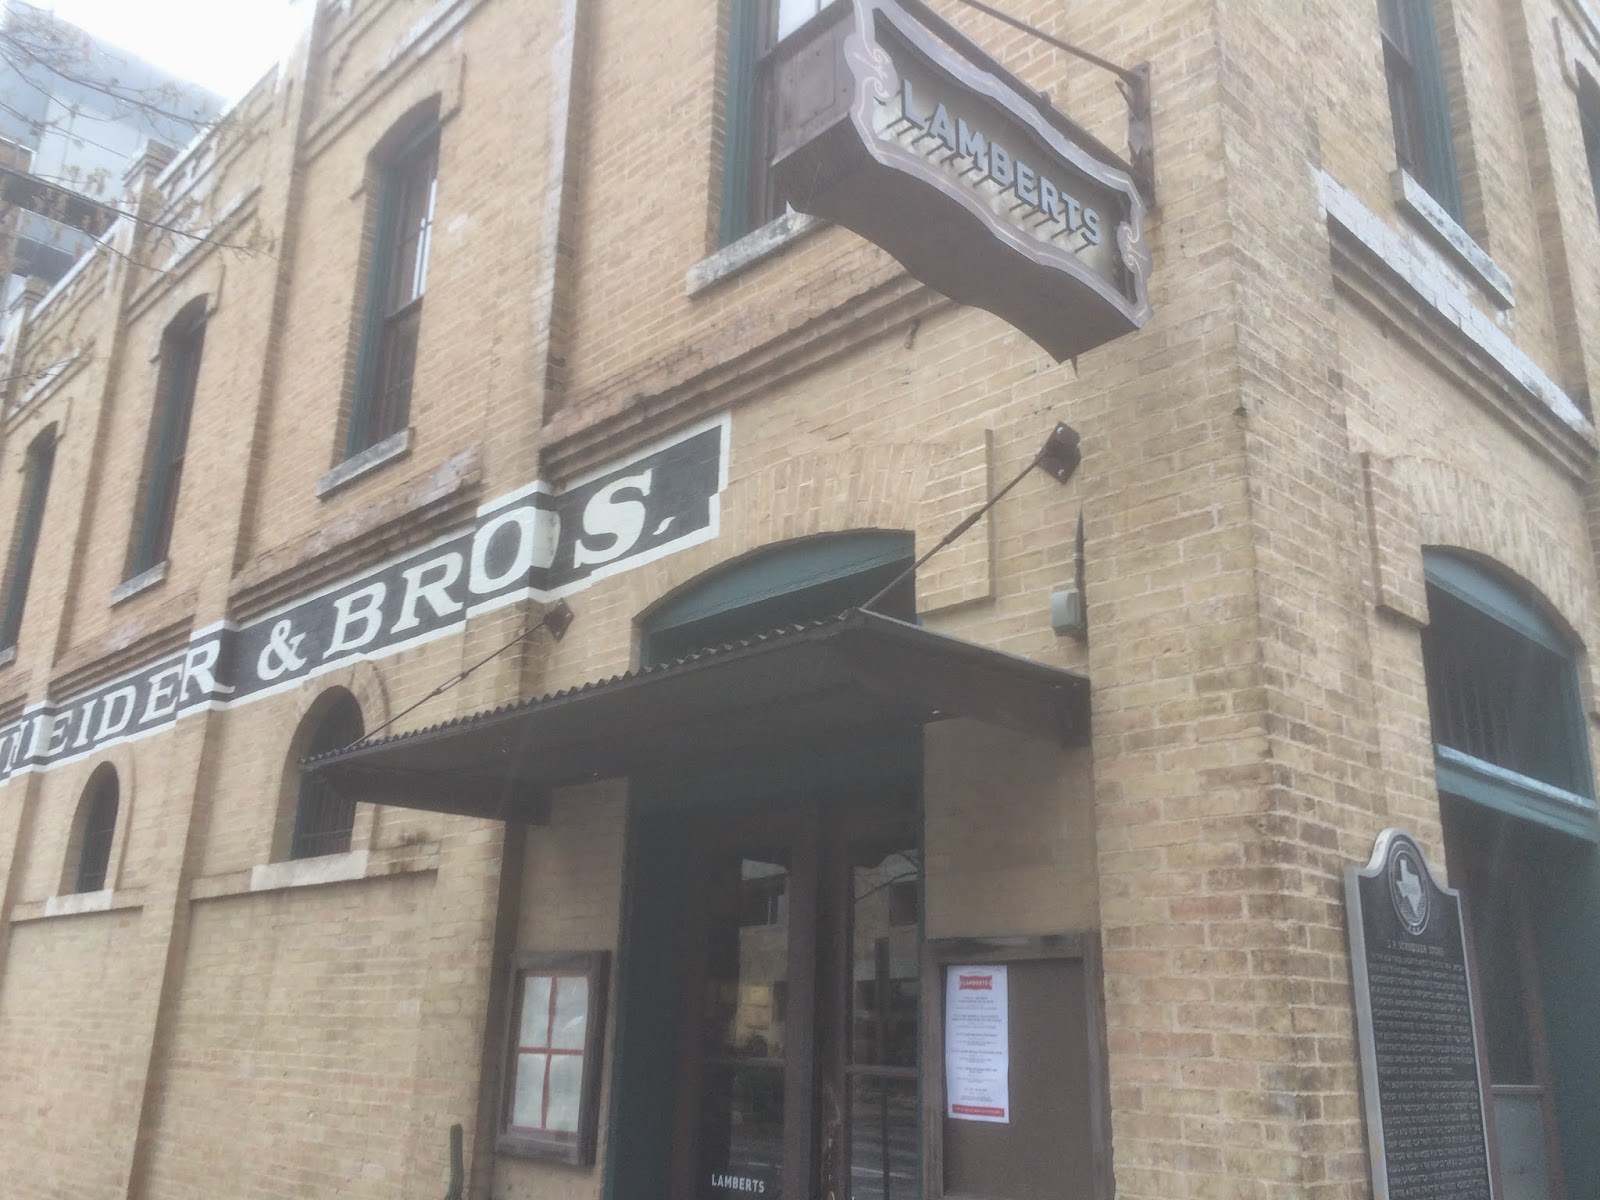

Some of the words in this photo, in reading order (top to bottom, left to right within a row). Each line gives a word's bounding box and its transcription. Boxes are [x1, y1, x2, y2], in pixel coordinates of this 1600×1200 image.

[901, 79, 1103, 246] LAMBERTS
[0, 639, 236, 773] NEIDER
[256, 618, 308, 680] &
[711, 1173, 765, 1193] LAMBERTS
